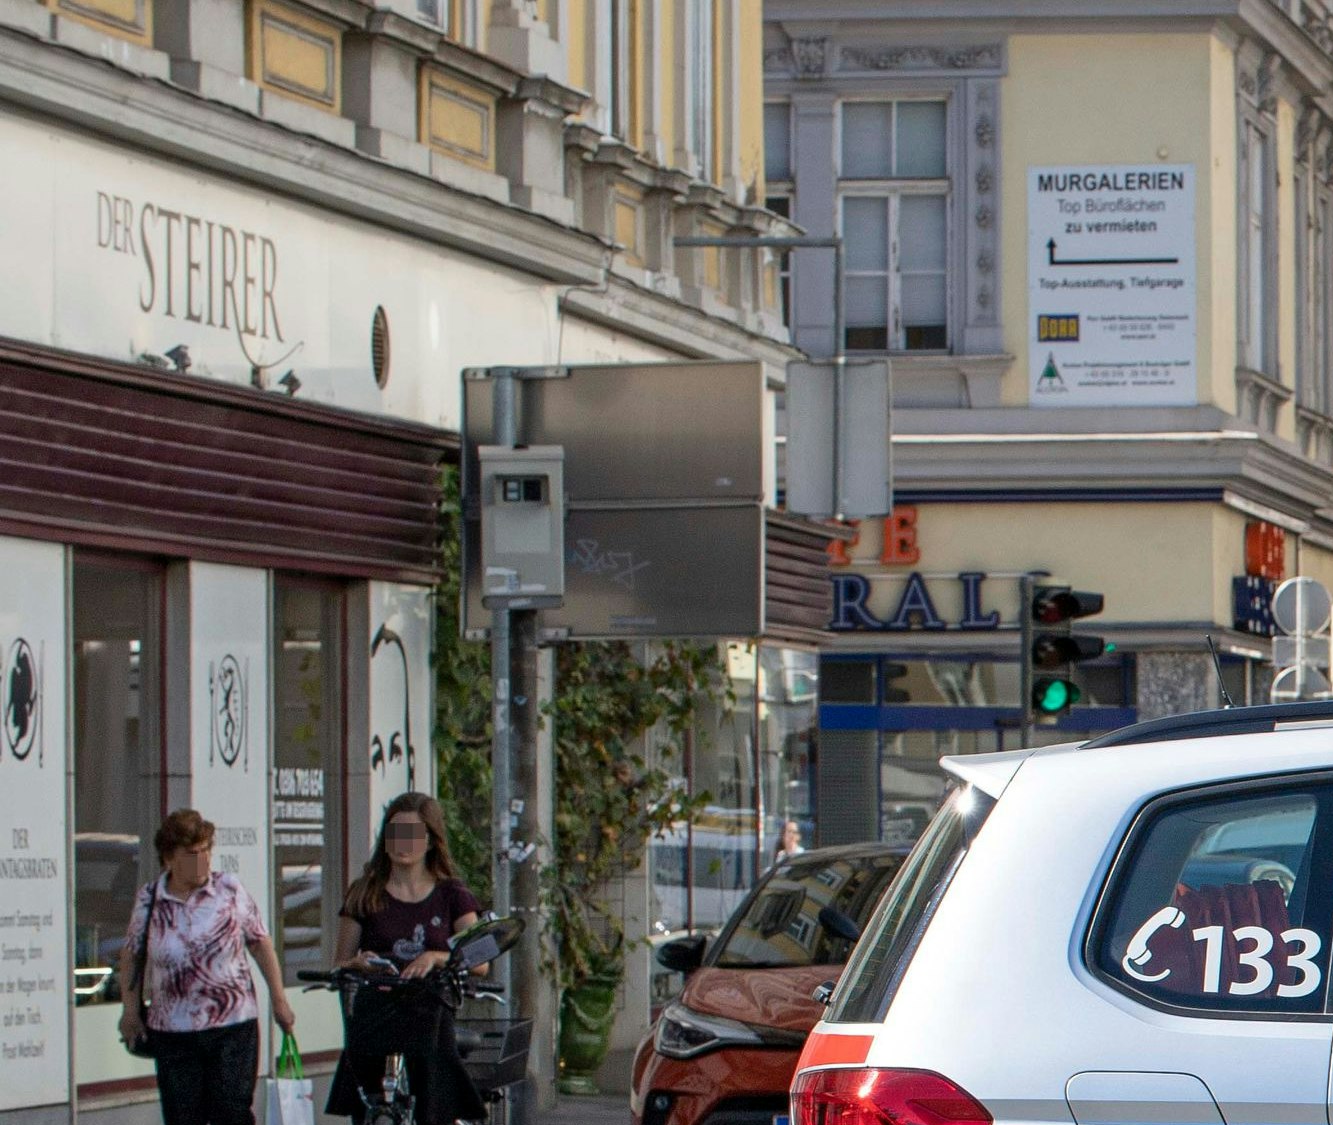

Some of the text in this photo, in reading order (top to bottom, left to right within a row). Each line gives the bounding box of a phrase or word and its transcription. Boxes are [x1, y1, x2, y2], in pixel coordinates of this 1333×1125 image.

[1038, 173, 1184, 191] MURGALERIEN
[1057, 198, 1166, 214] Top Büroflächen
[1065, 219, 1157, 233] zu vermieten
[97, 191, 304, 368] DER STEIRER
[1192, 925, 1322, 998] 133
